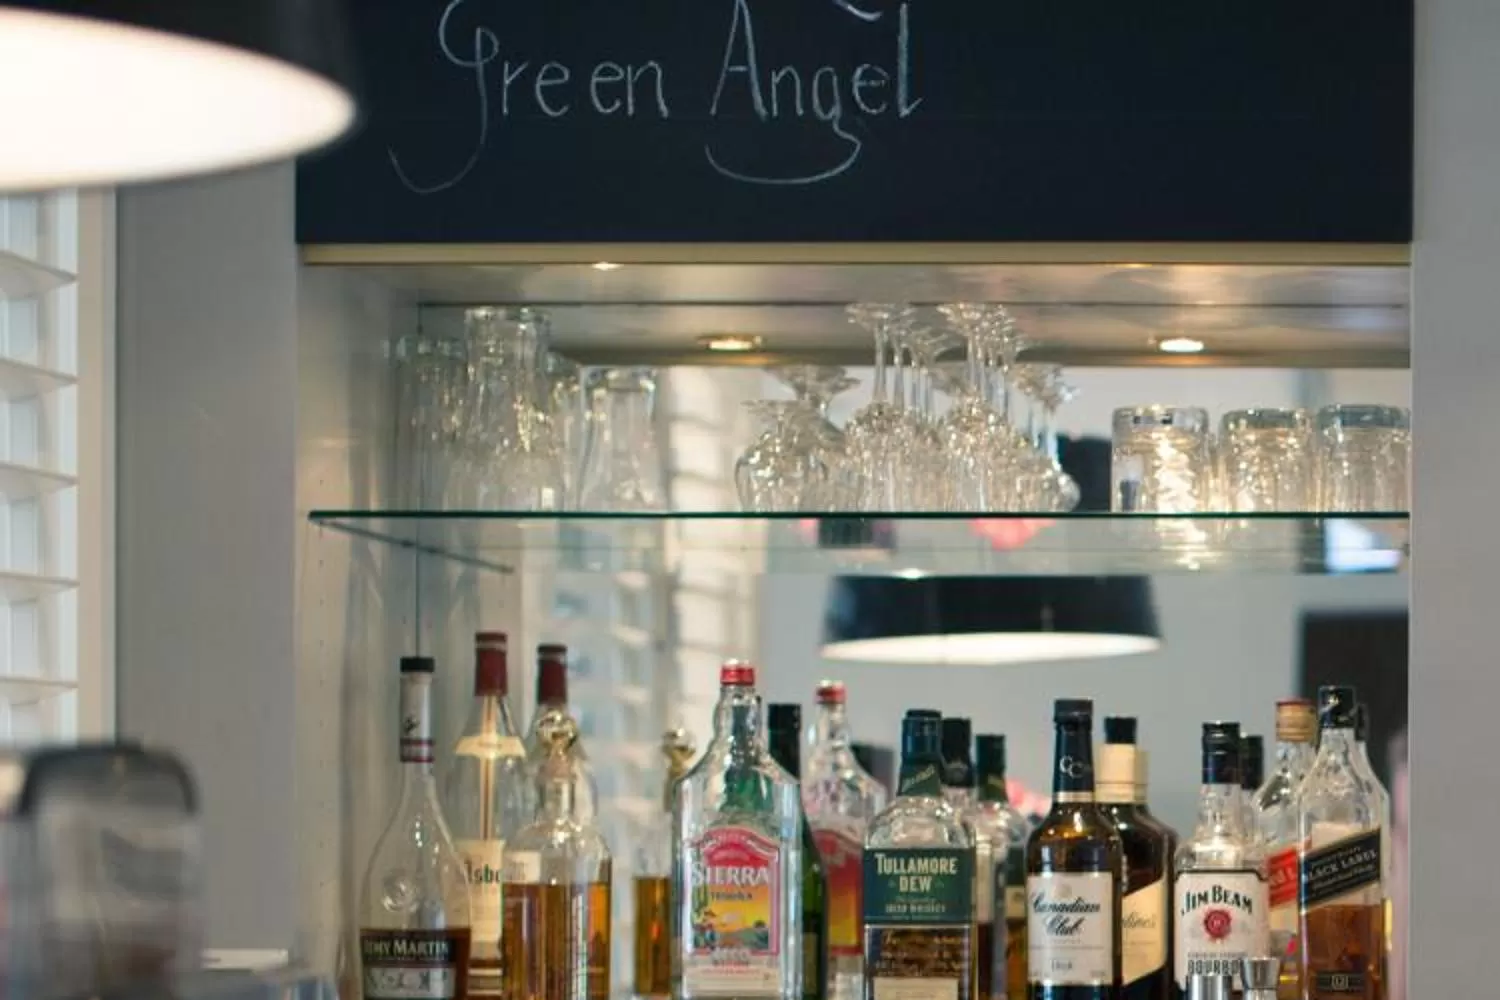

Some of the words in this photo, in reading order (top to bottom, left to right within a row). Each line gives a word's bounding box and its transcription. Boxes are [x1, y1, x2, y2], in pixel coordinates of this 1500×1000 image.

[388, 0, 669, 193] Green
[705, 0, 924, 185] Angel
[691, 862, 771, 887] SIERRA
[874, 852, 960, 876] TULLAMORE
[899, 875, 933, 893] DEW
[1180, 890, 1209, 916] JIM
[1211, 885, 1254, 915] BEAM
